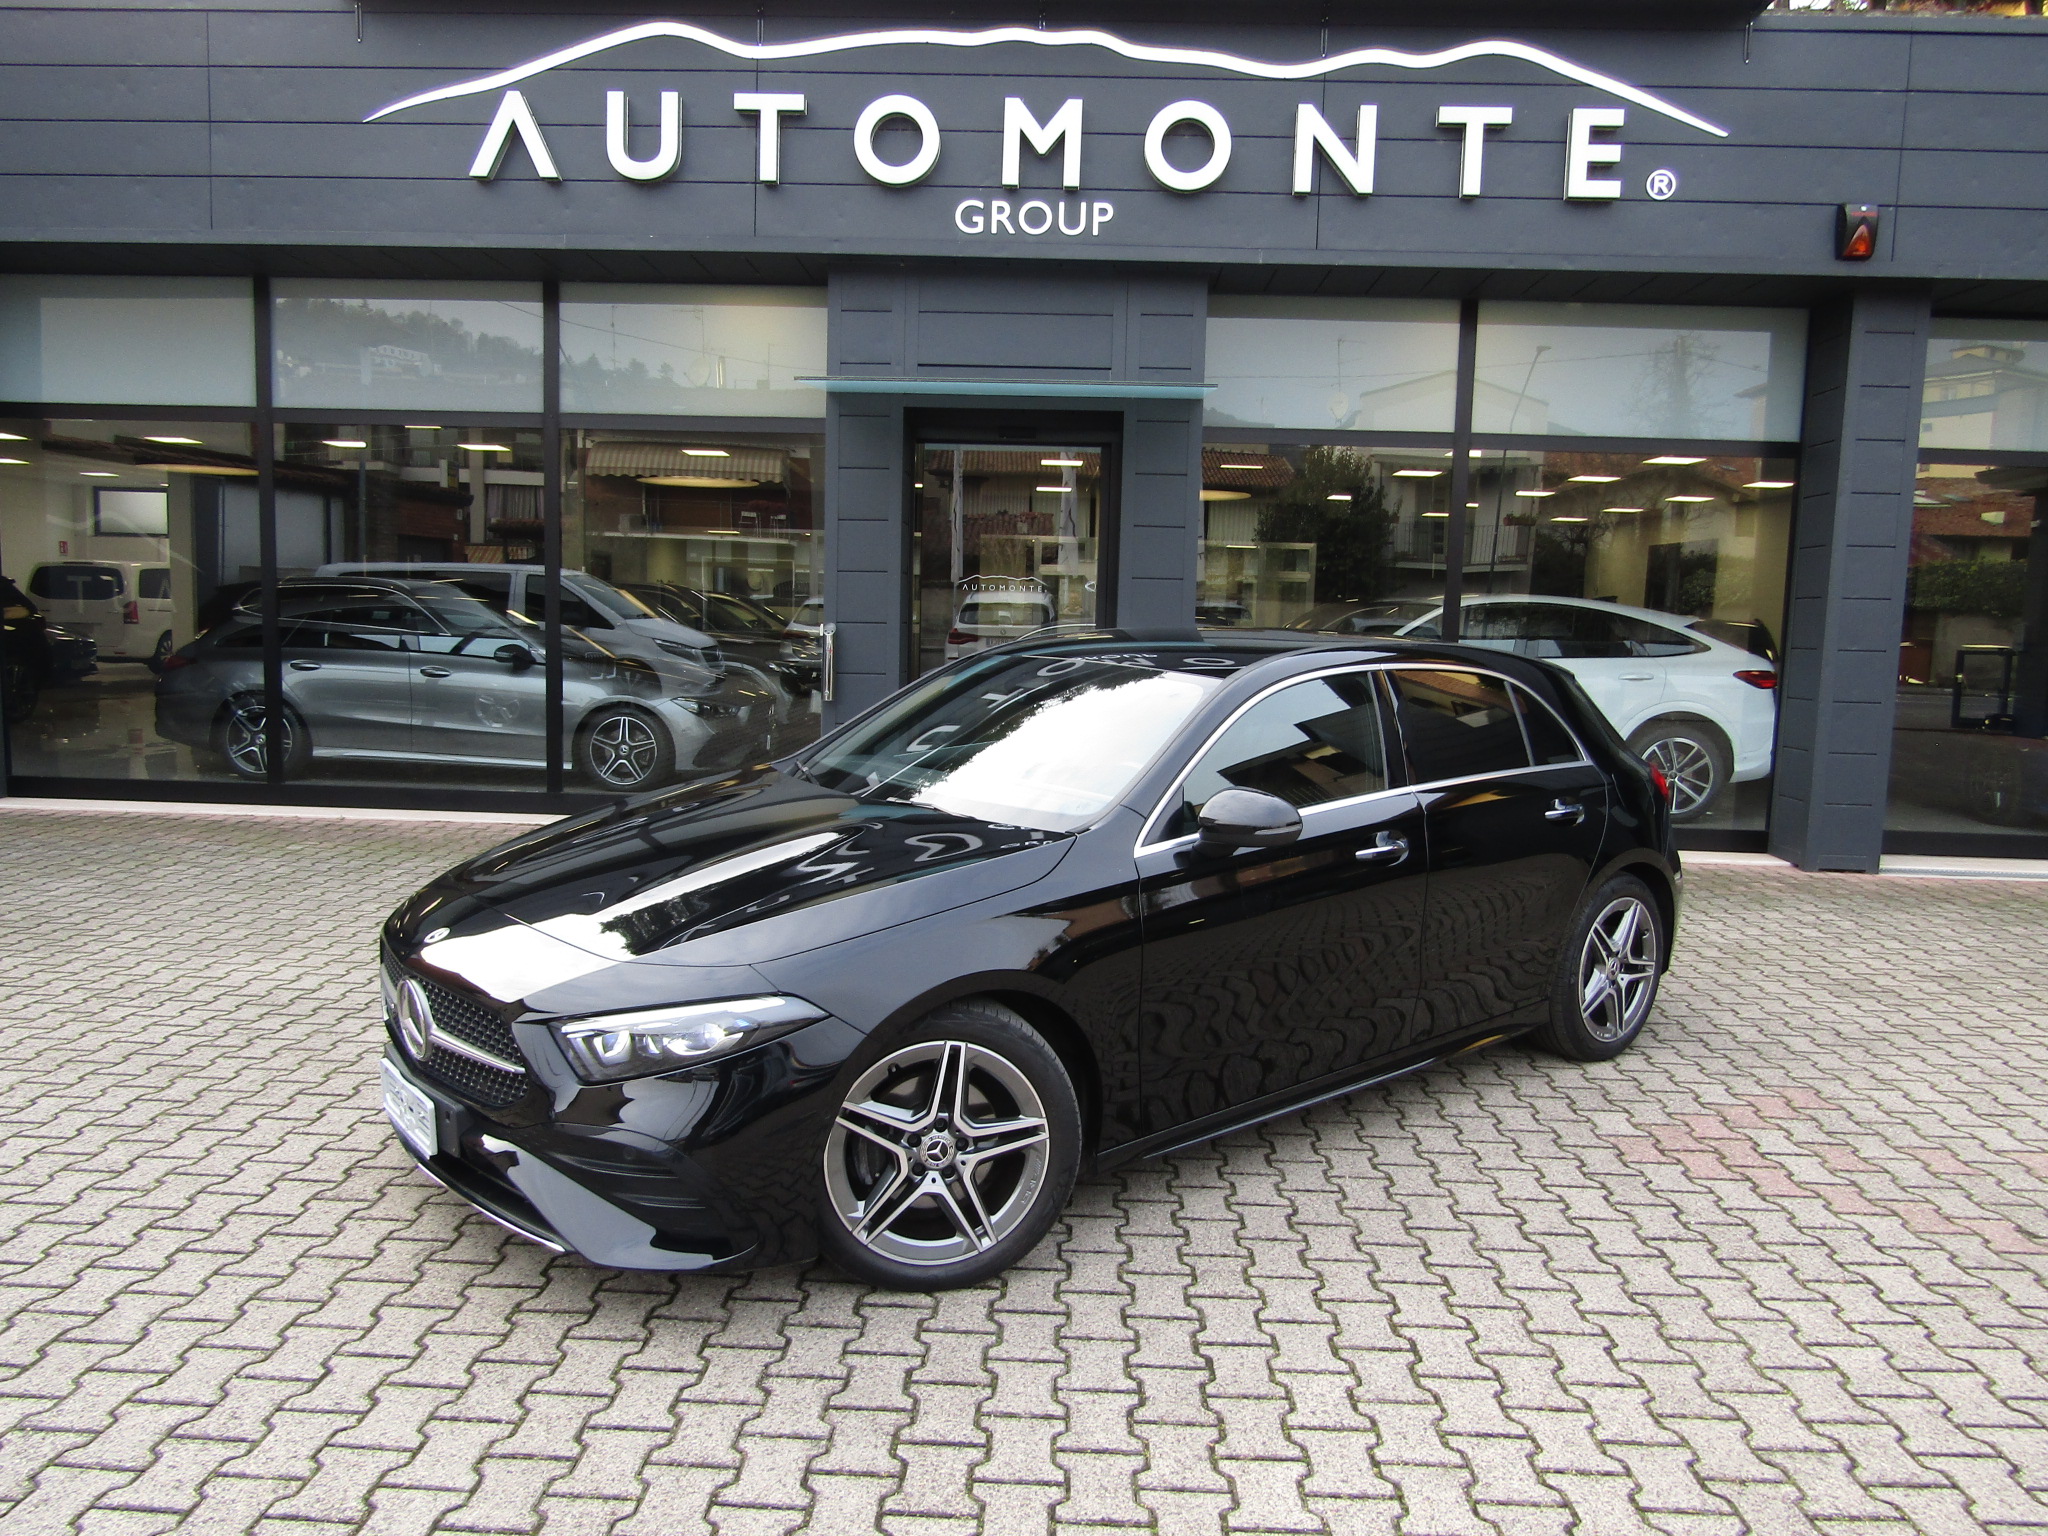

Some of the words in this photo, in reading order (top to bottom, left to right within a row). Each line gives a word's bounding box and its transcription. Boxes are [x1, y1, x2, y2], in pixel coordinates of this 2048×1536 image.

[468, 90, 1626, 199] AUTOMONTE
[954, 199, 1115, 236] GROUP
[962, 583, 1042, 593] AUTOMONTE
